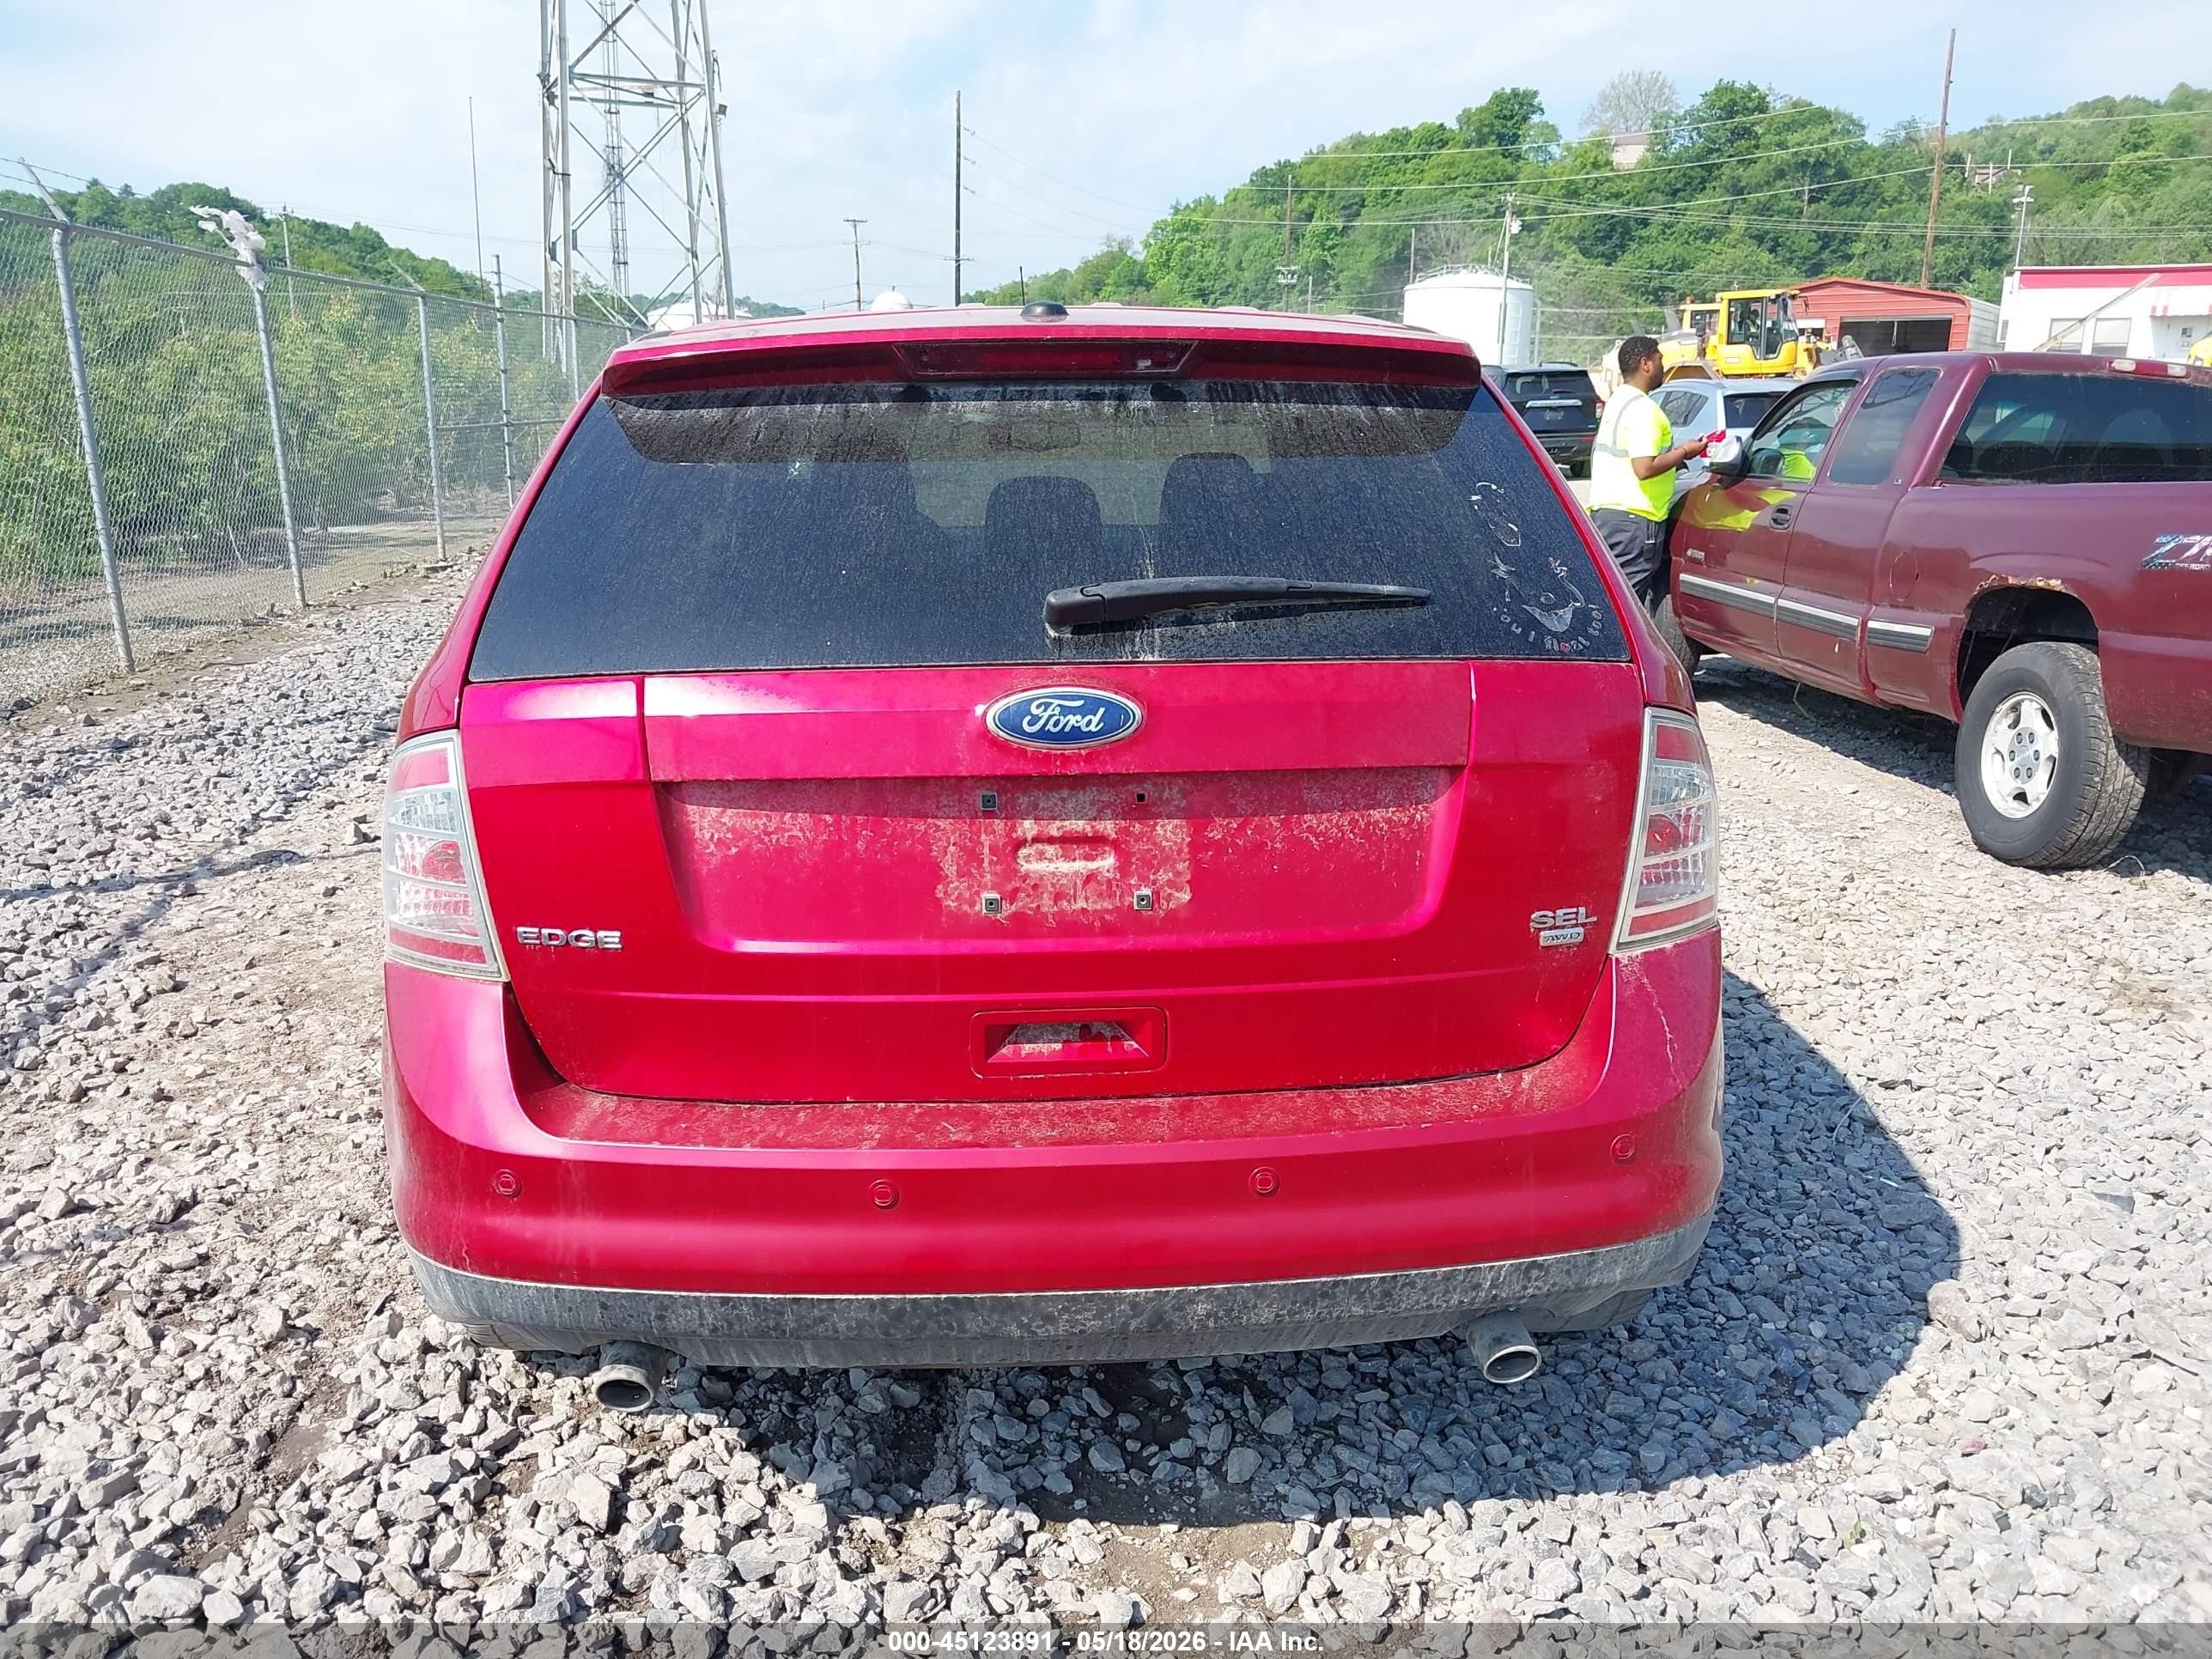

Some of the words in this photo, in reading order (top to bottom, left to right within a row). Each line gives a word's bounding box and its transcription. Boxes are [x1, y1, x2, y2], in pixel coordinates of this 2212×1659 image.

[1022, 698, 1105, 732] Ford
[1530, 907, 1597, 928] SEL
[516, 927, 622, 949] EDGE
[1545, 932, 1581, 943] AWD
